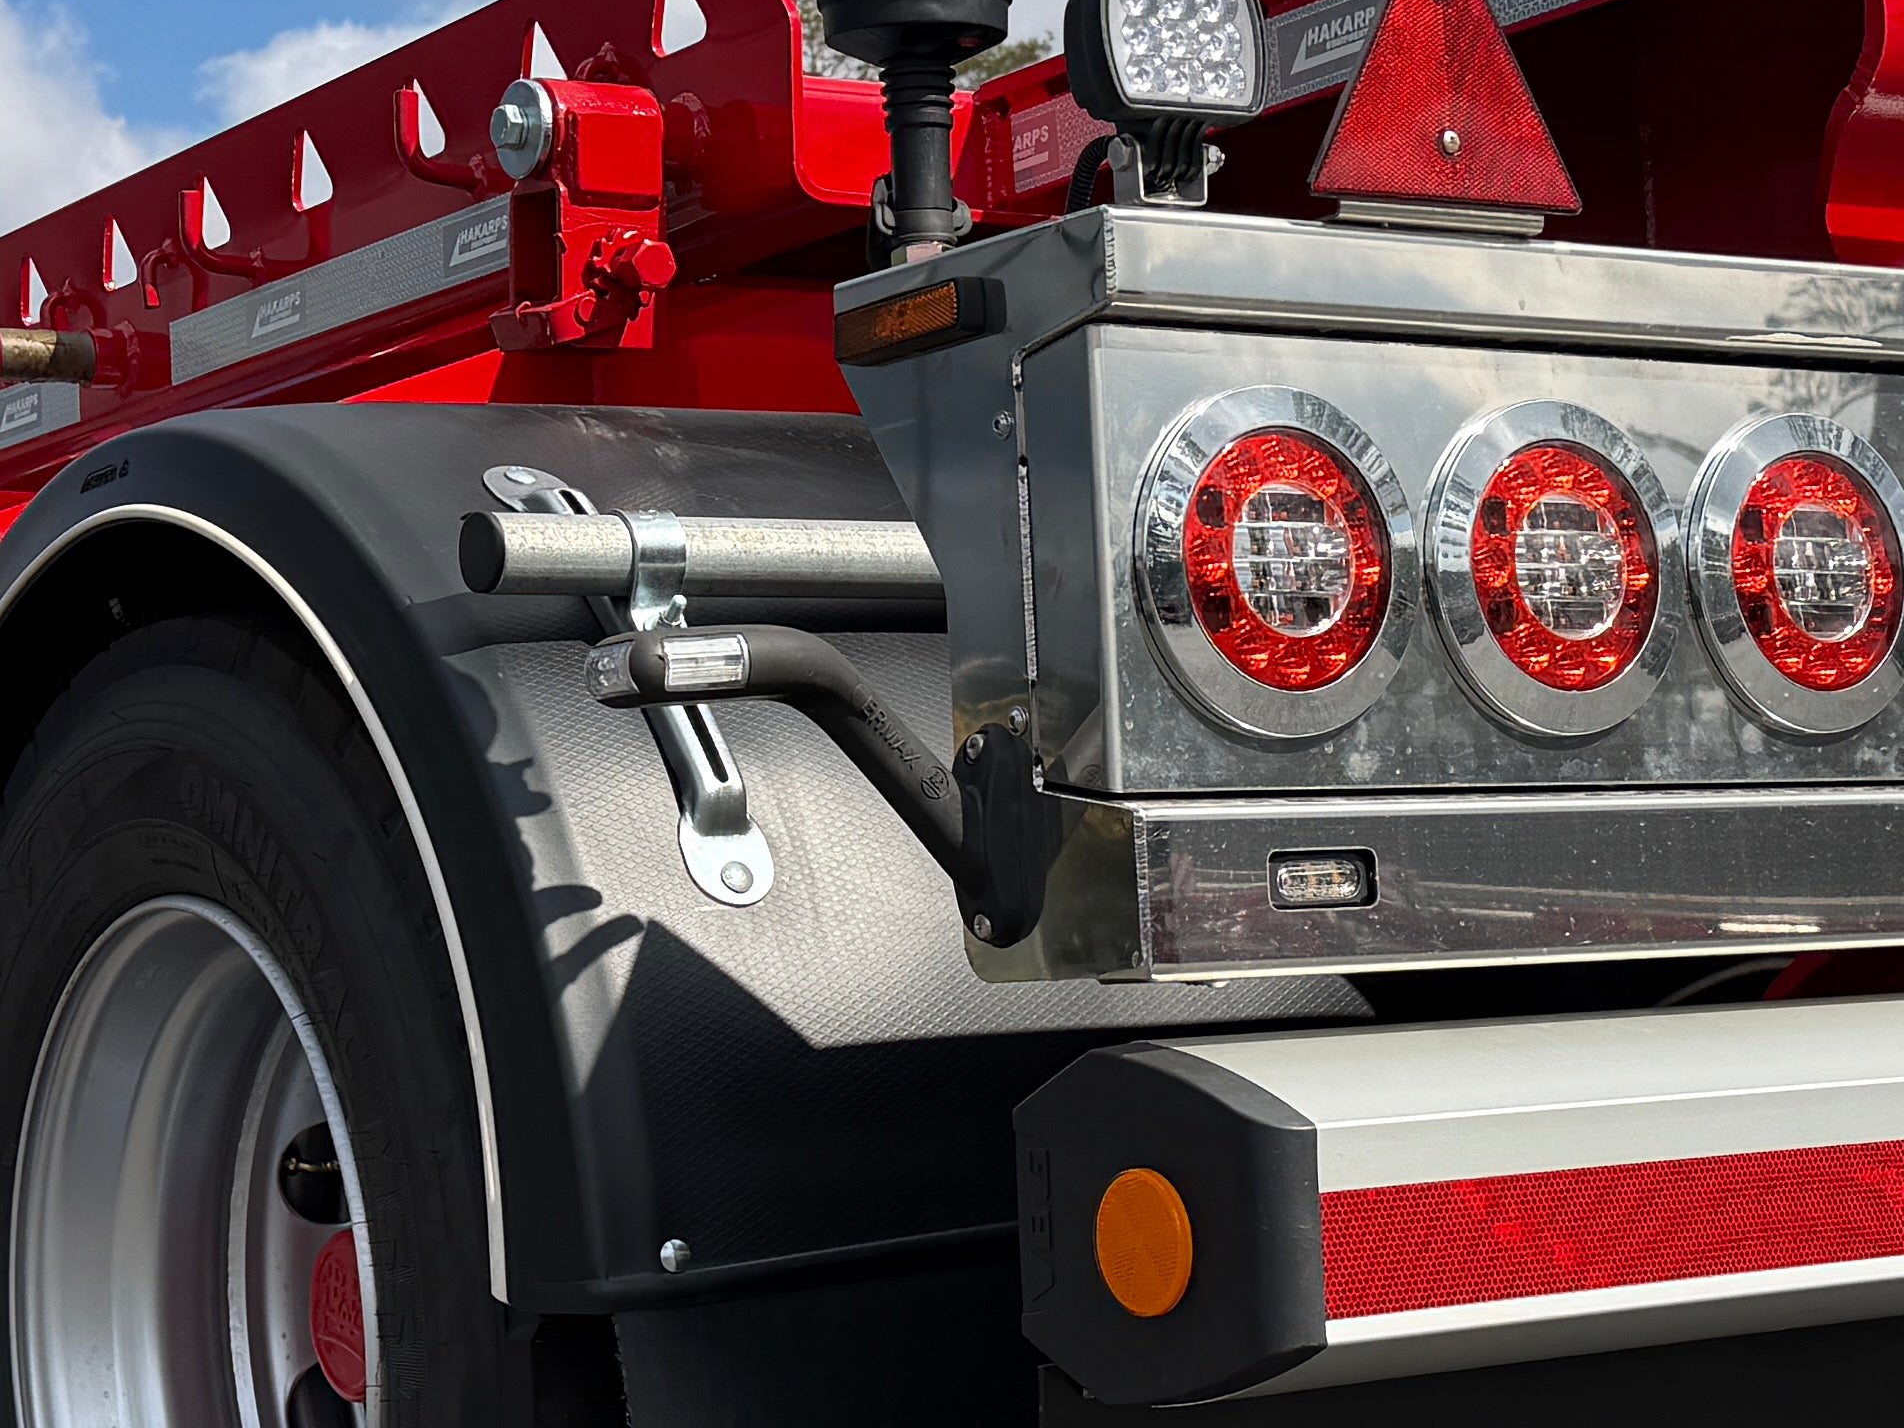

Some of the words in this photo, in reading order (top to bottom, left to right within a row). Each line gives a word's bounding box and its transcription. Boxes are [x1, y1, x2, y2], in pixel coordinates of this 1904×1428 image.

[1307, 6, 1376, 47] HAKARP
[1012, 125, 1049, 153] ARPS
[458, 214, 508, 246] HAKARPS
